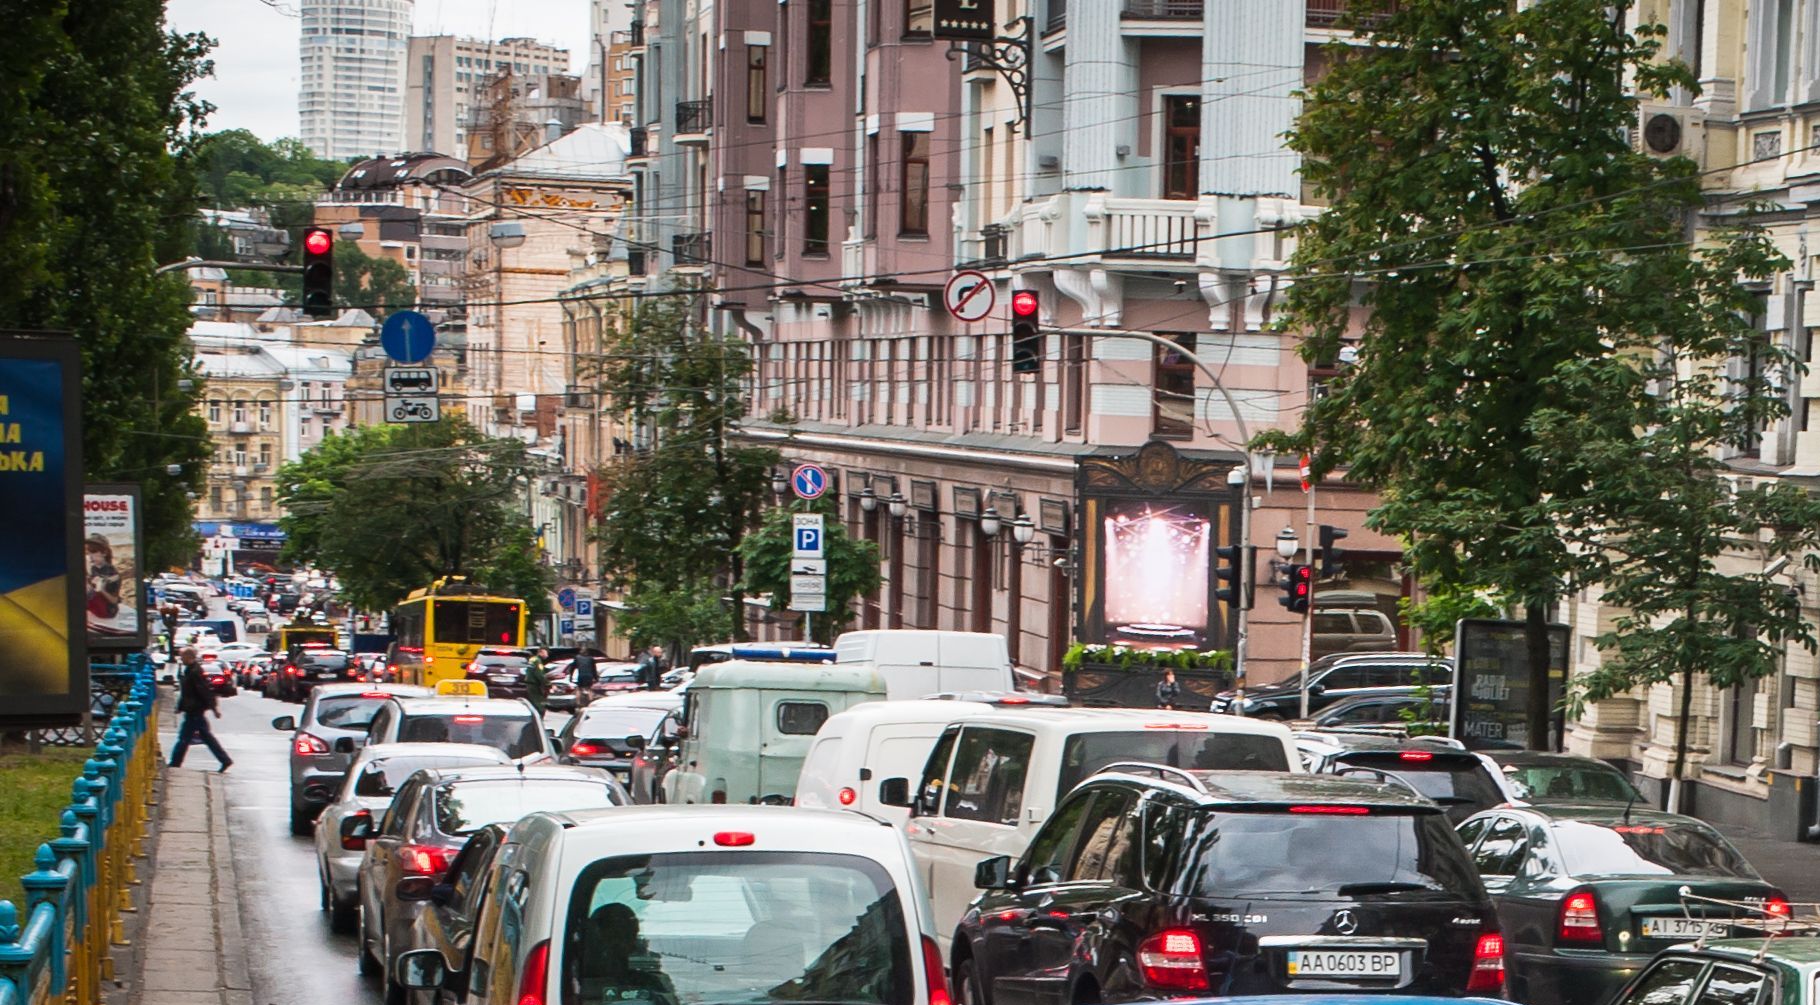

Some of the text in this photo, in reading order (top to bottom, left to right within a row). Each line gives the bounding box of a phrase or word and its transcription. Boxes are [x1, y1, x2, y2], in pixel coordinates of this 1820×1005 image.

[1300, 955, 1395, 971] AA 0603 BP
